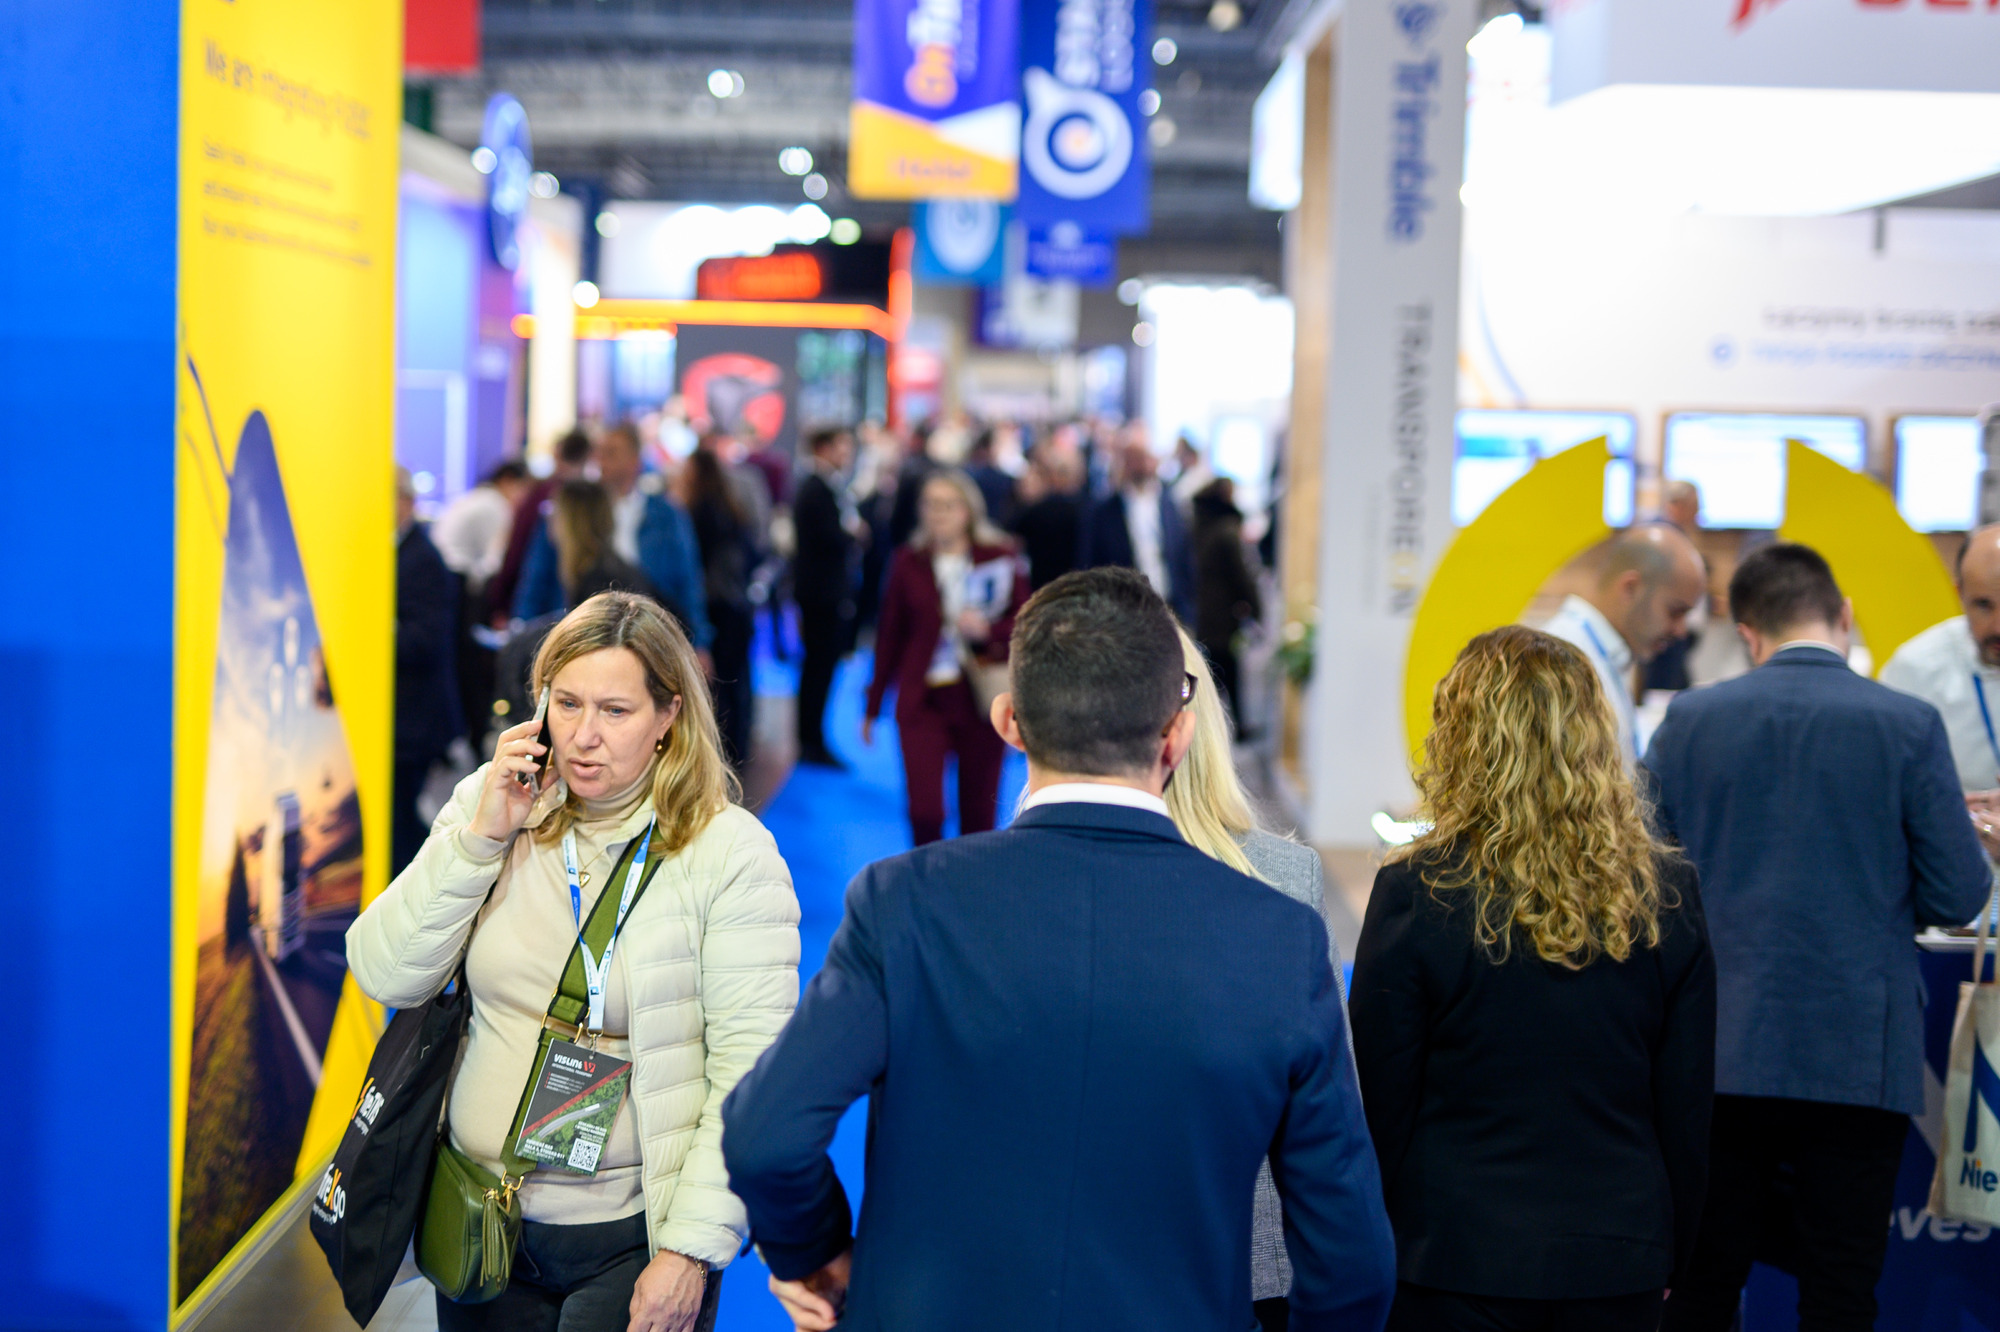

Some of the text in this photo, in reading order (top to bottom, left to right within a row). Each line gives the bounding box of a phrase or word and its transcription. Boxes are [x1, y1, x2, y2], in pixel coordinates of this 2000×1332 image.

[1389, 54, 1440, 242] Trimble
[1960, 1157, 2000, 1193] Nie
[1889, 1206, 1992, 1242] ves
